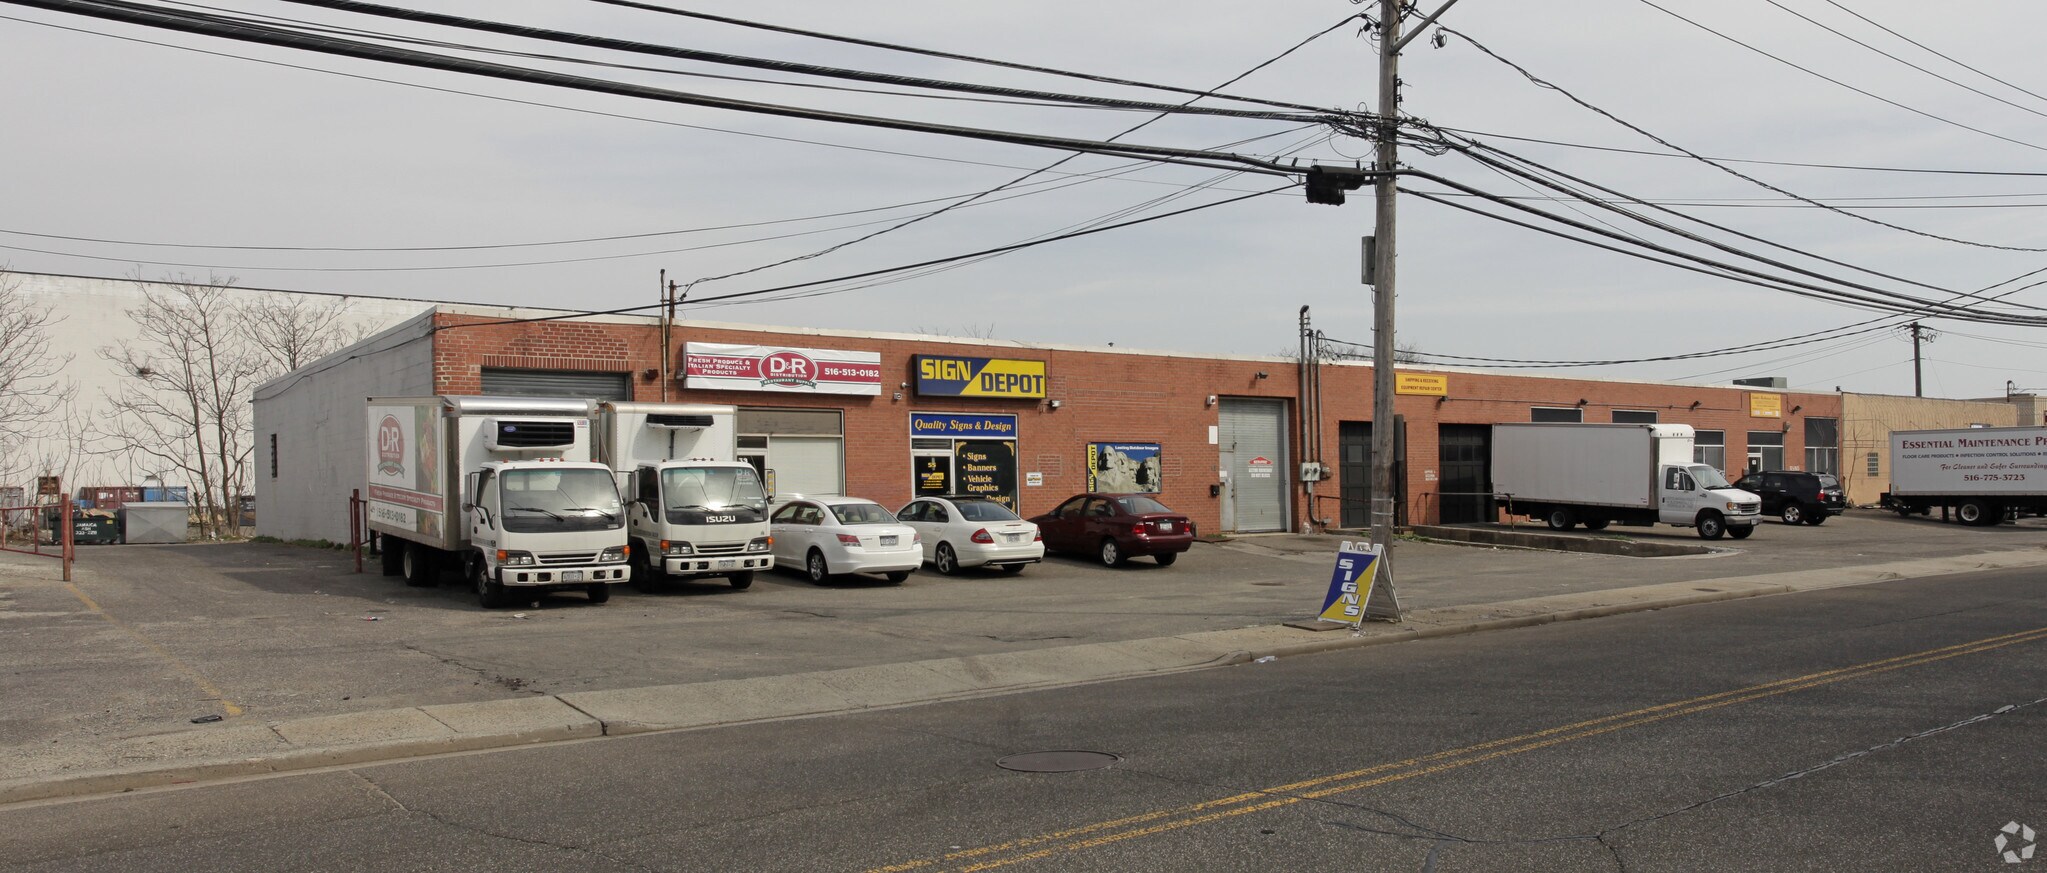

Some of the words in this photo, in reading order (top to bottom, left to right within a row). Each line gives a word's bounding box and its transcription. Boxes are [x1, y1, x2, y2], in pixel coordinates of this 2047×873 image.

[715, 363, 751, 371] SPECIALTY
[769, 356, 807, 374] D&R
[920, 358, 971, 381] SIGN
[702, 368, 738, 376] PRODUCTS
[824, 367, 880, 378] 516-513-0182
[796, 379, 814, 387] SUPPLY
[980, 372, 1044, 394] DEPOT
[914, 418, 946, 431] Quality
[949, 419, 973, 431] Signs
[974, 421, 982, 430] &
[983, 420, 1012, 432] Design
[1902, 440, 1955, 449] ESSENTIAL
[1958, 438, 2031, 448] MAINTENANCE
[966, 452, 987, 462] Signs
[967, 463, 997, 471] Banners
[1940, 463, 1951, 471] For
[1953, 462, 1976, 470] Cleaner
[1977, 462, 1988, 470] and
[1989, 462, 2008, 471] Safer
[967, 474, 993, 483] Vehicle
[1963, 474, 2026, 482] 516-775-3723
[967, 483, 999, 493] Graphics
[705, 515, 736, 523] ISUZU
[1338, 558, 1361, 617] SIGNS
